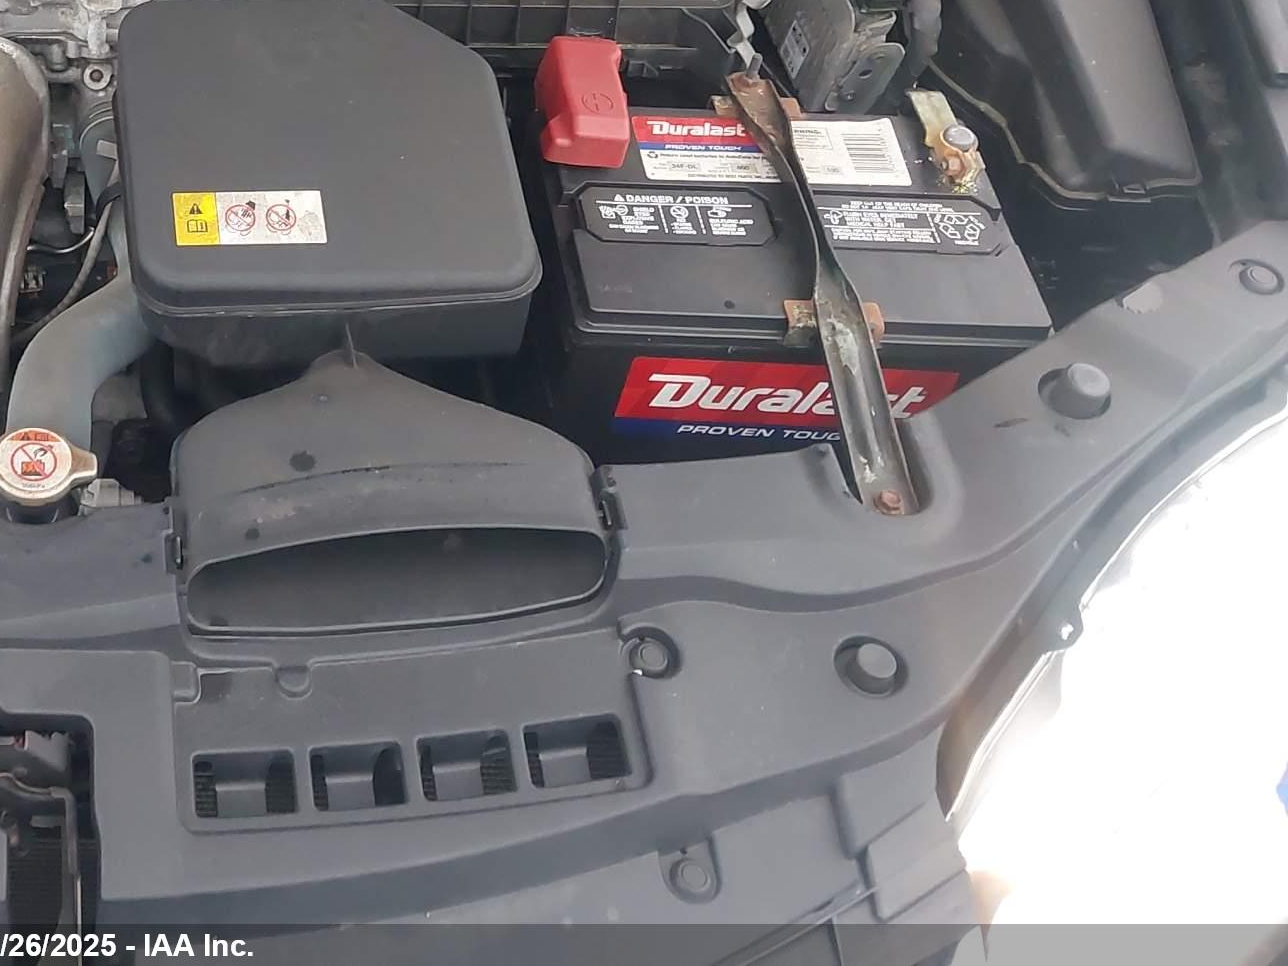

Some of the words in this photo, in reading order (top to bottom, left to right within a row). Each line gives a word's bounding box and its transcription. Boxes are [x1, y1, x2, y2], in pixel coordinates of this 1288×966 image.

[647, 120, 747, 137] Duralast
[625, 194, 674, 203] DANGER
[684, 195, 728, 205] POISON
[649, 374, 927, 418] Duralat
[677, 425, 774, 437] PROVEN
